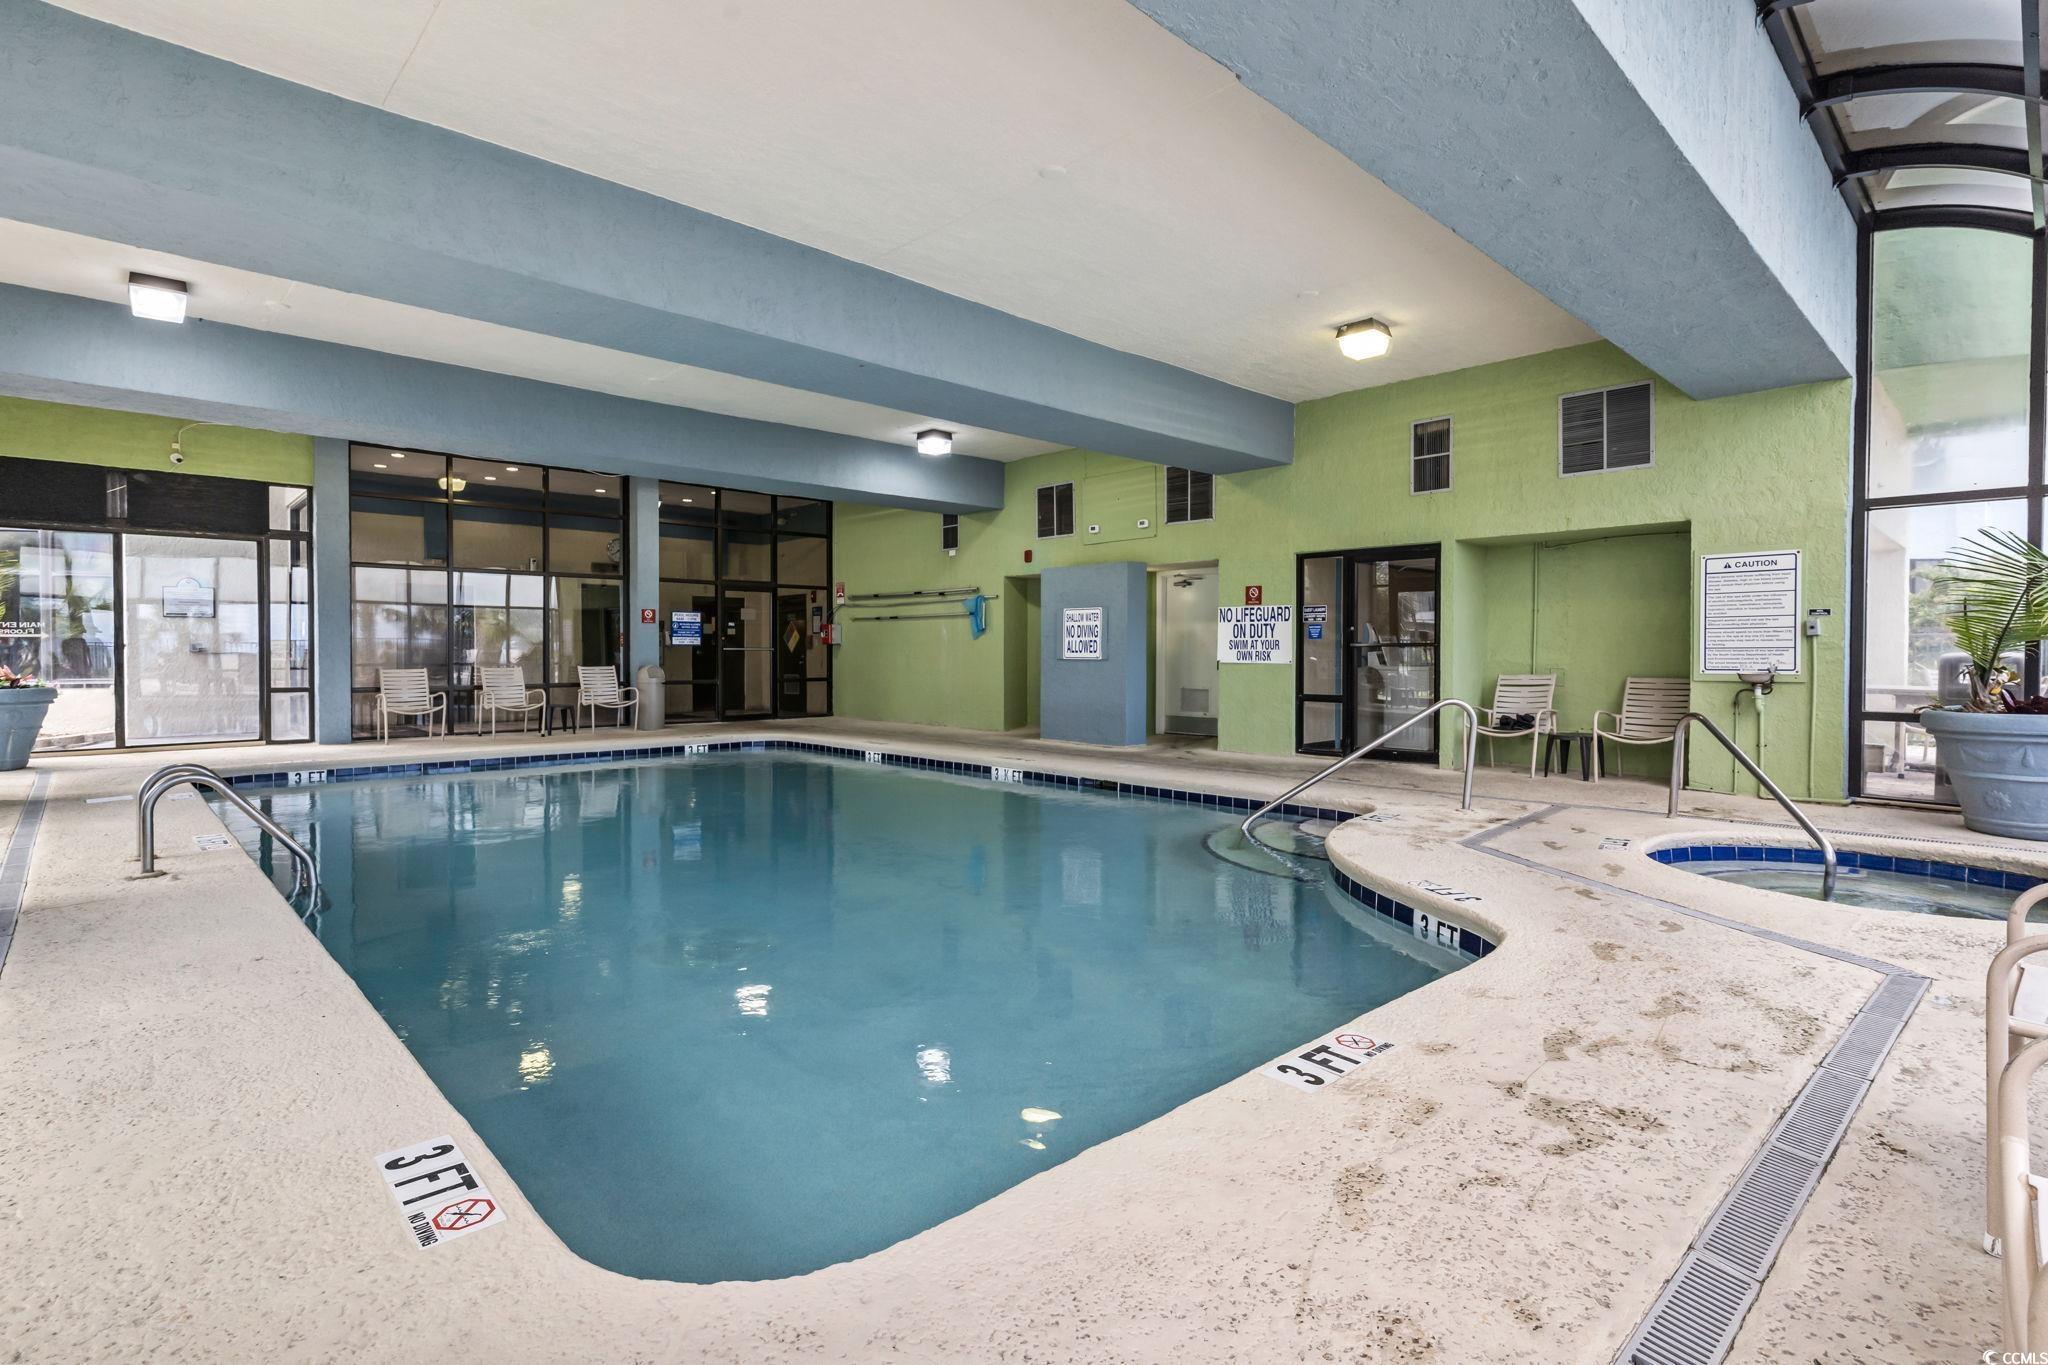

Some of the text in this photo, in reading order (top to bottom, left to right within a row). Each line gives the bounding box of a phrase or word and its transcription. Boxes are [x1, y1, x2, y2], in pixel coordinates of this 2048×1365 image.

[1735, 560, 1778, 568] CAUTION
[1066, 612, 1099, 622] SHALLOW WATER
[1219, 606, 1291, 623] NO LIFEGUARD
[1066, 624, 1099, 638] NO DIVING
[1232, 623, 1276, 639] ON DUTY
[1067, 640, 1098, 653] ALLOWED
[1228, 640, 1280, 650] SWIM AT YOUR
[1236, 651, 1272, 661] OWN RISK
[1437, 920, 1459, 944] FT
[1276, 1044, 1362, 1086] 3 FT
[384, 1144, 479, 1206] 3 FT
[407, 1211, 439, 1248] NO DIVING
